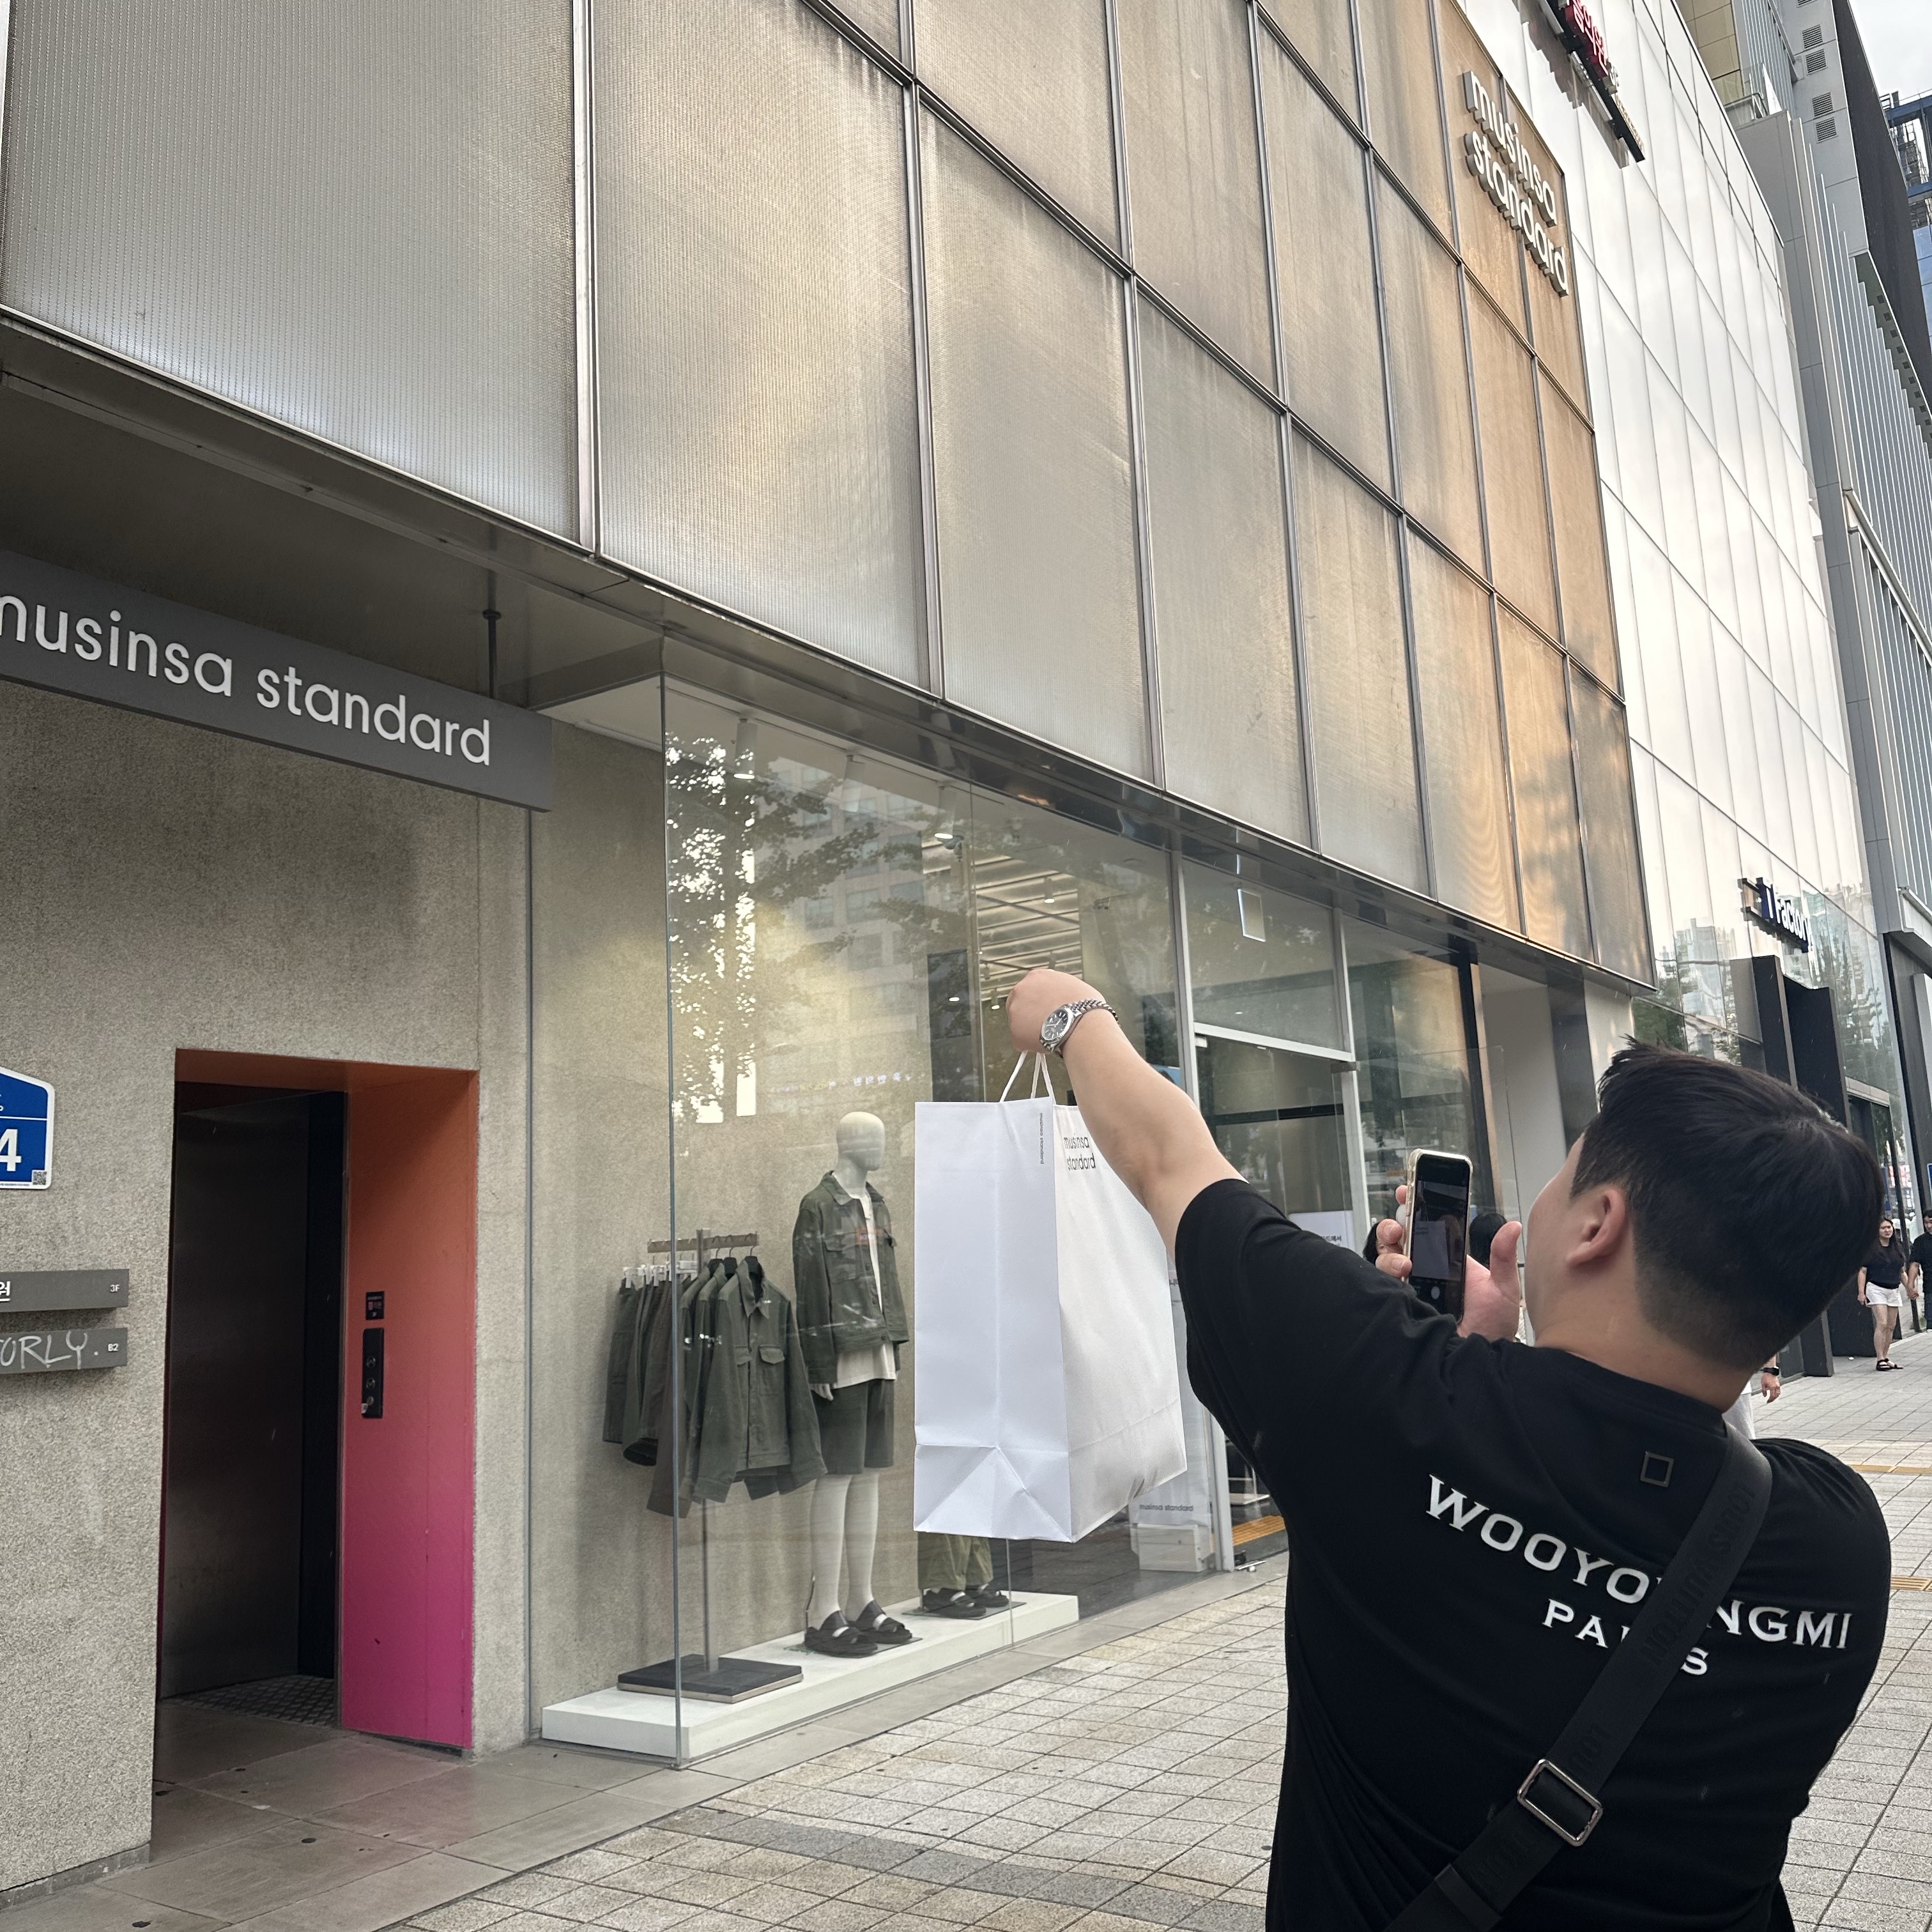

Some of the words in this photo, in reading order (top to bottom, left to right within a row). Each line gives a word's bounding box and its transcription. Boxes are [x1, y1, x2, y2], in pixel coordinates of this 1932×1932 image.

[1469, 70, 1557, 226] musinsa
[1471, 130, 1569, 296] standard
[256, 666, 491, 767] standard
[1063, 1133, 1090, 1149] musinsa
[1066, 1153, 1096, 1170] standard
[110, 1284, 120, 1292] 3F
[107, 1343, 119, 1352] B2
[1425, 1474, 1853, 1650] WOOYONGMI
[1542, 1598, 1710, 1677] PAS
